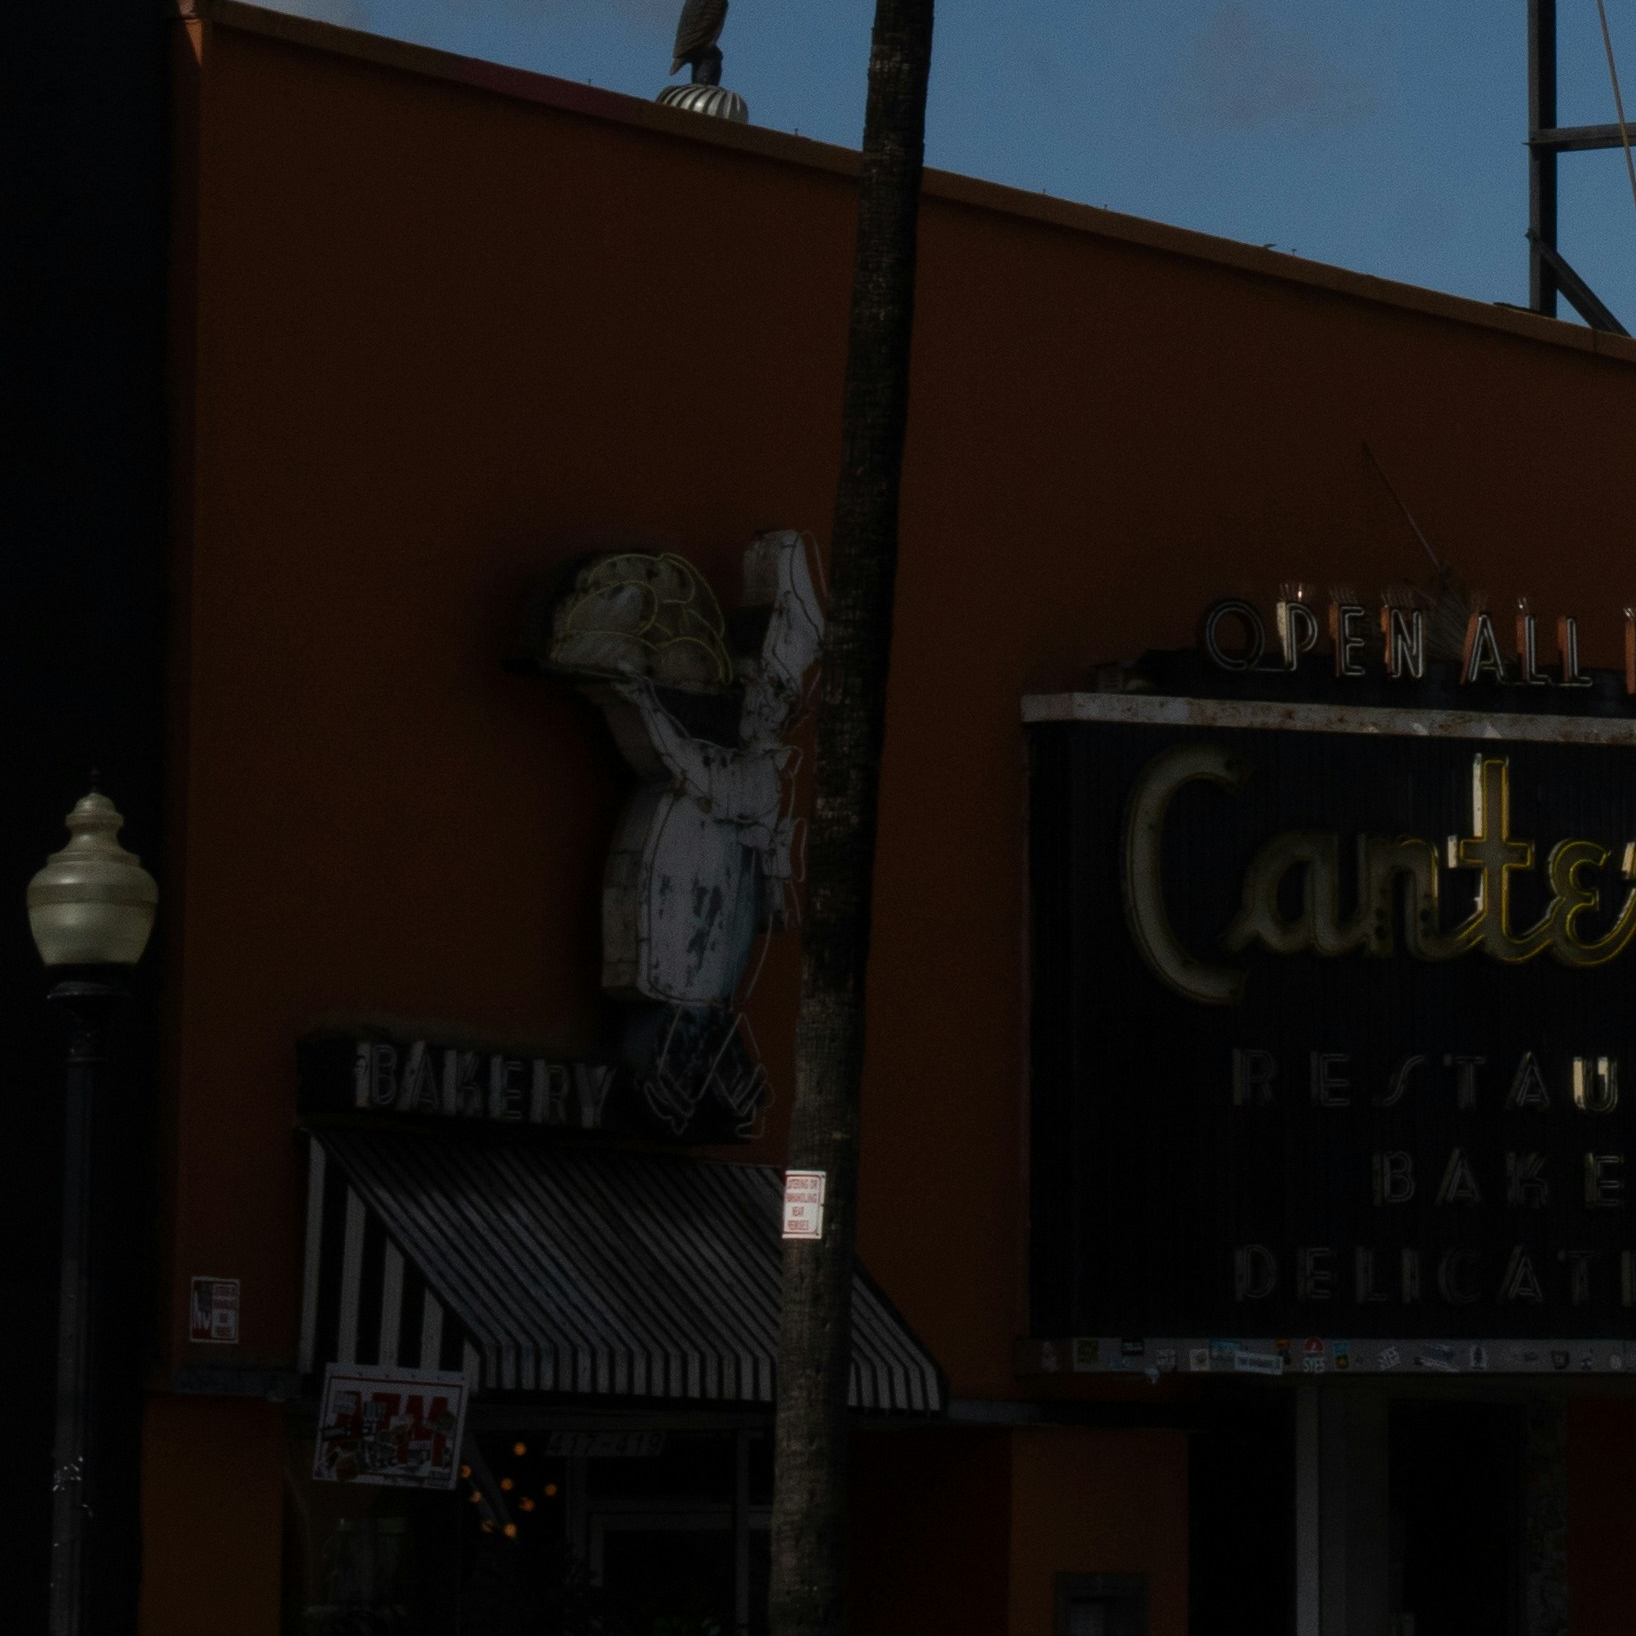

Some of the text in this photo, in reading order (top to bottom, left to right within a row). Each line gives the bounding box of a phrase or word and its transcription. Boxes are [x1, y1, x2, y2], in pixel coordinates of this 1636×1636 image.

[1199, 597, 1426, 680] OPEN
[1461, 611, 1594, 689] ALL
[354, 1040, 617, 1129] BAKERY
